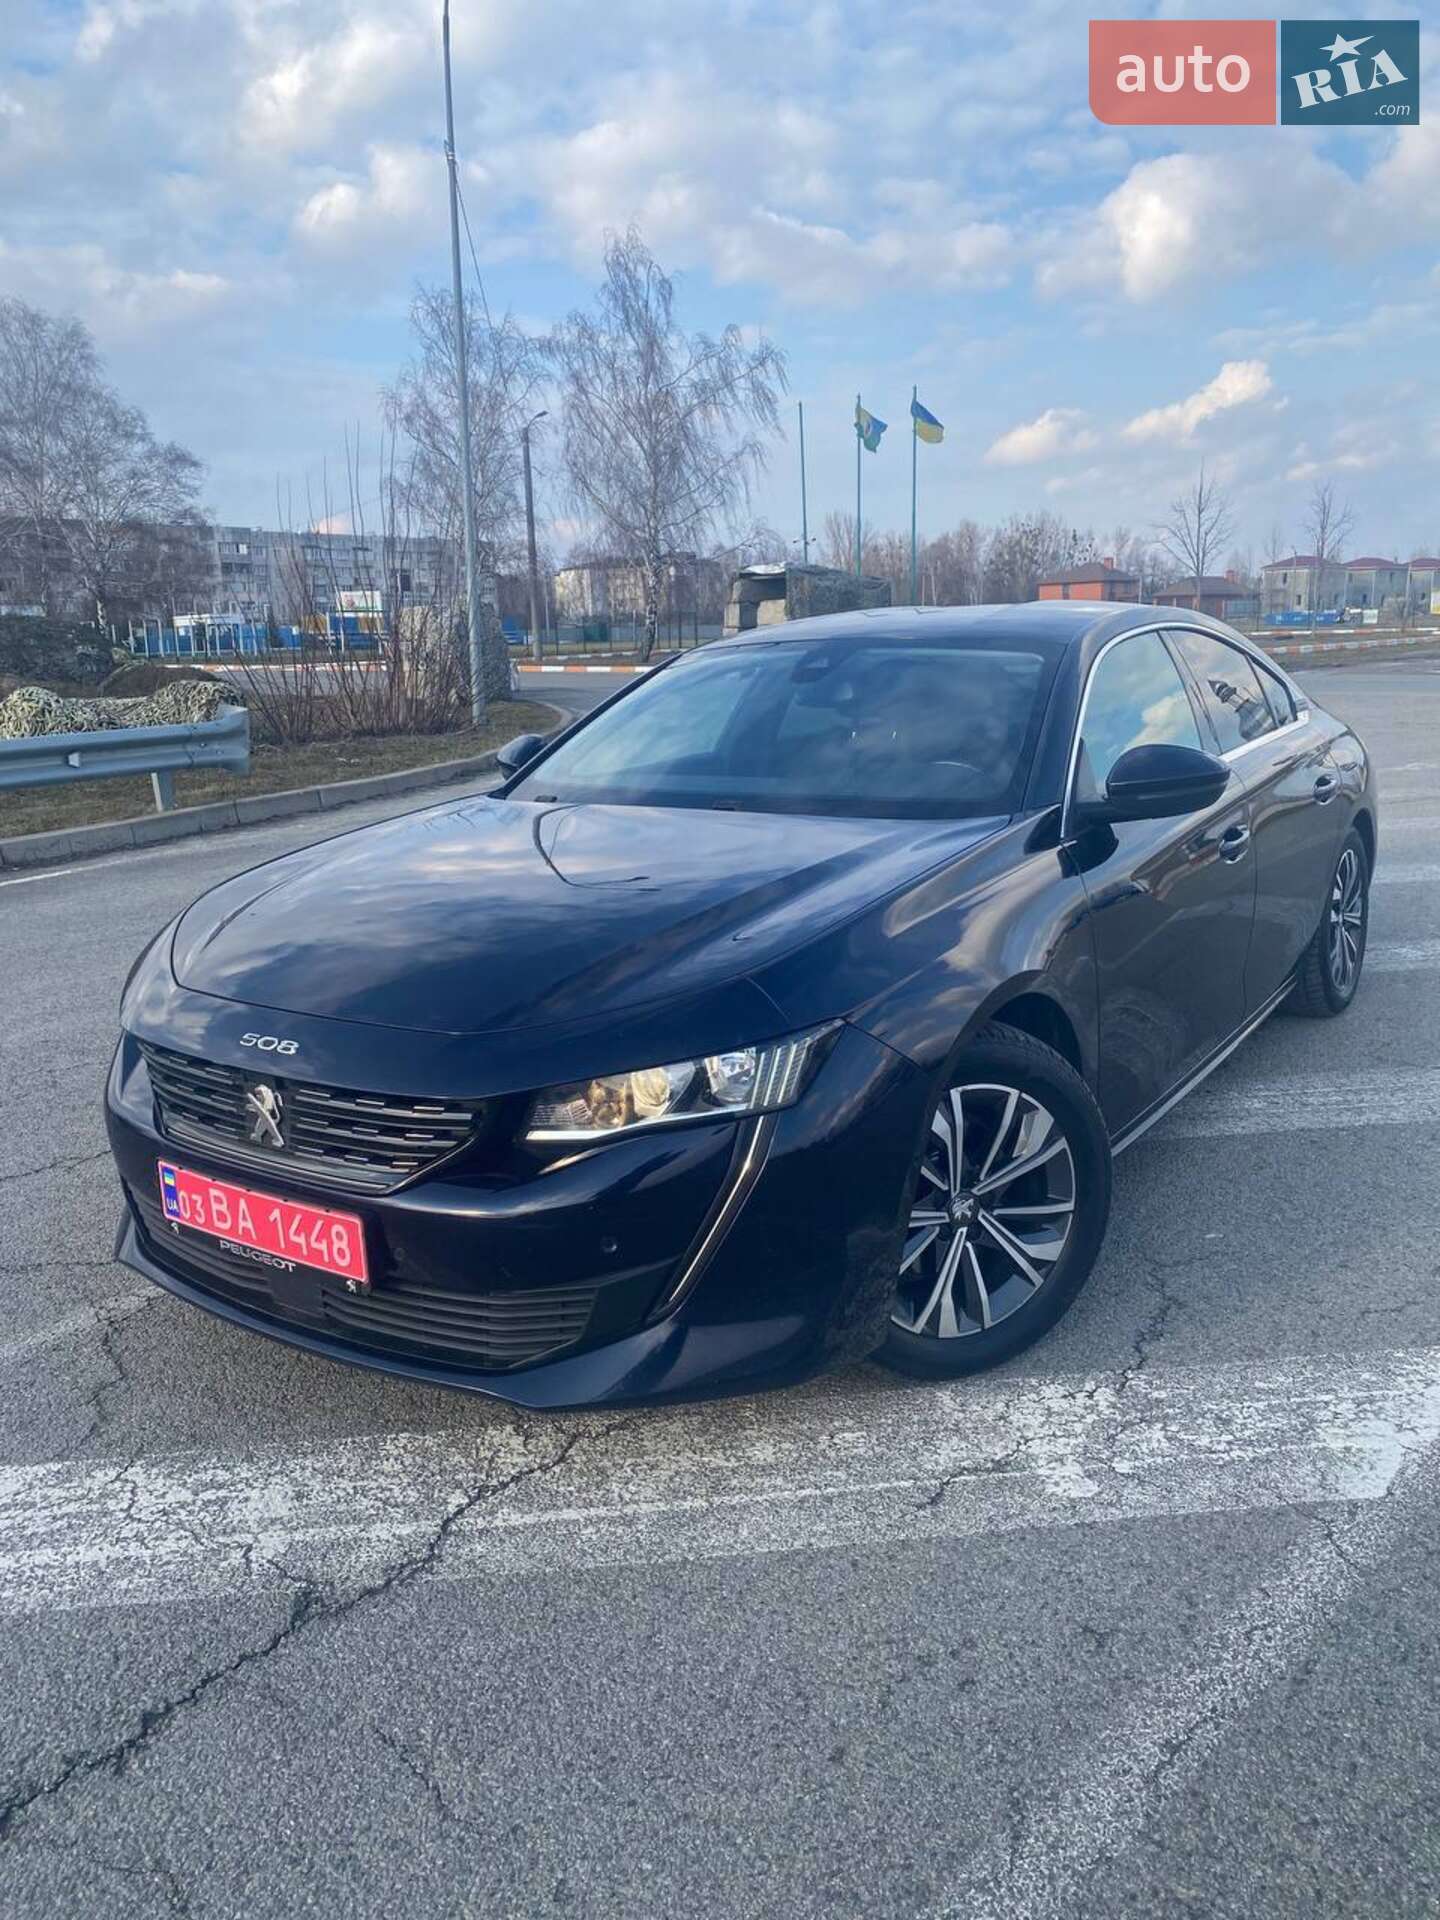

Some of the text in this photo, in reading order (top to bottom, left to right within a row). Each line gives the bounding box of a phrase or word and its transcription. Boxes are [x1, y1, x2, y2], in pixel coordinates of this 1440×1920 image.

[239, 1032, 300, 1055] 508
[166, 1197, 180, 1213] UA
[268, 1207, 352, 1268] 1448
[219, 1239, 297, 1273] PEUGEOT
